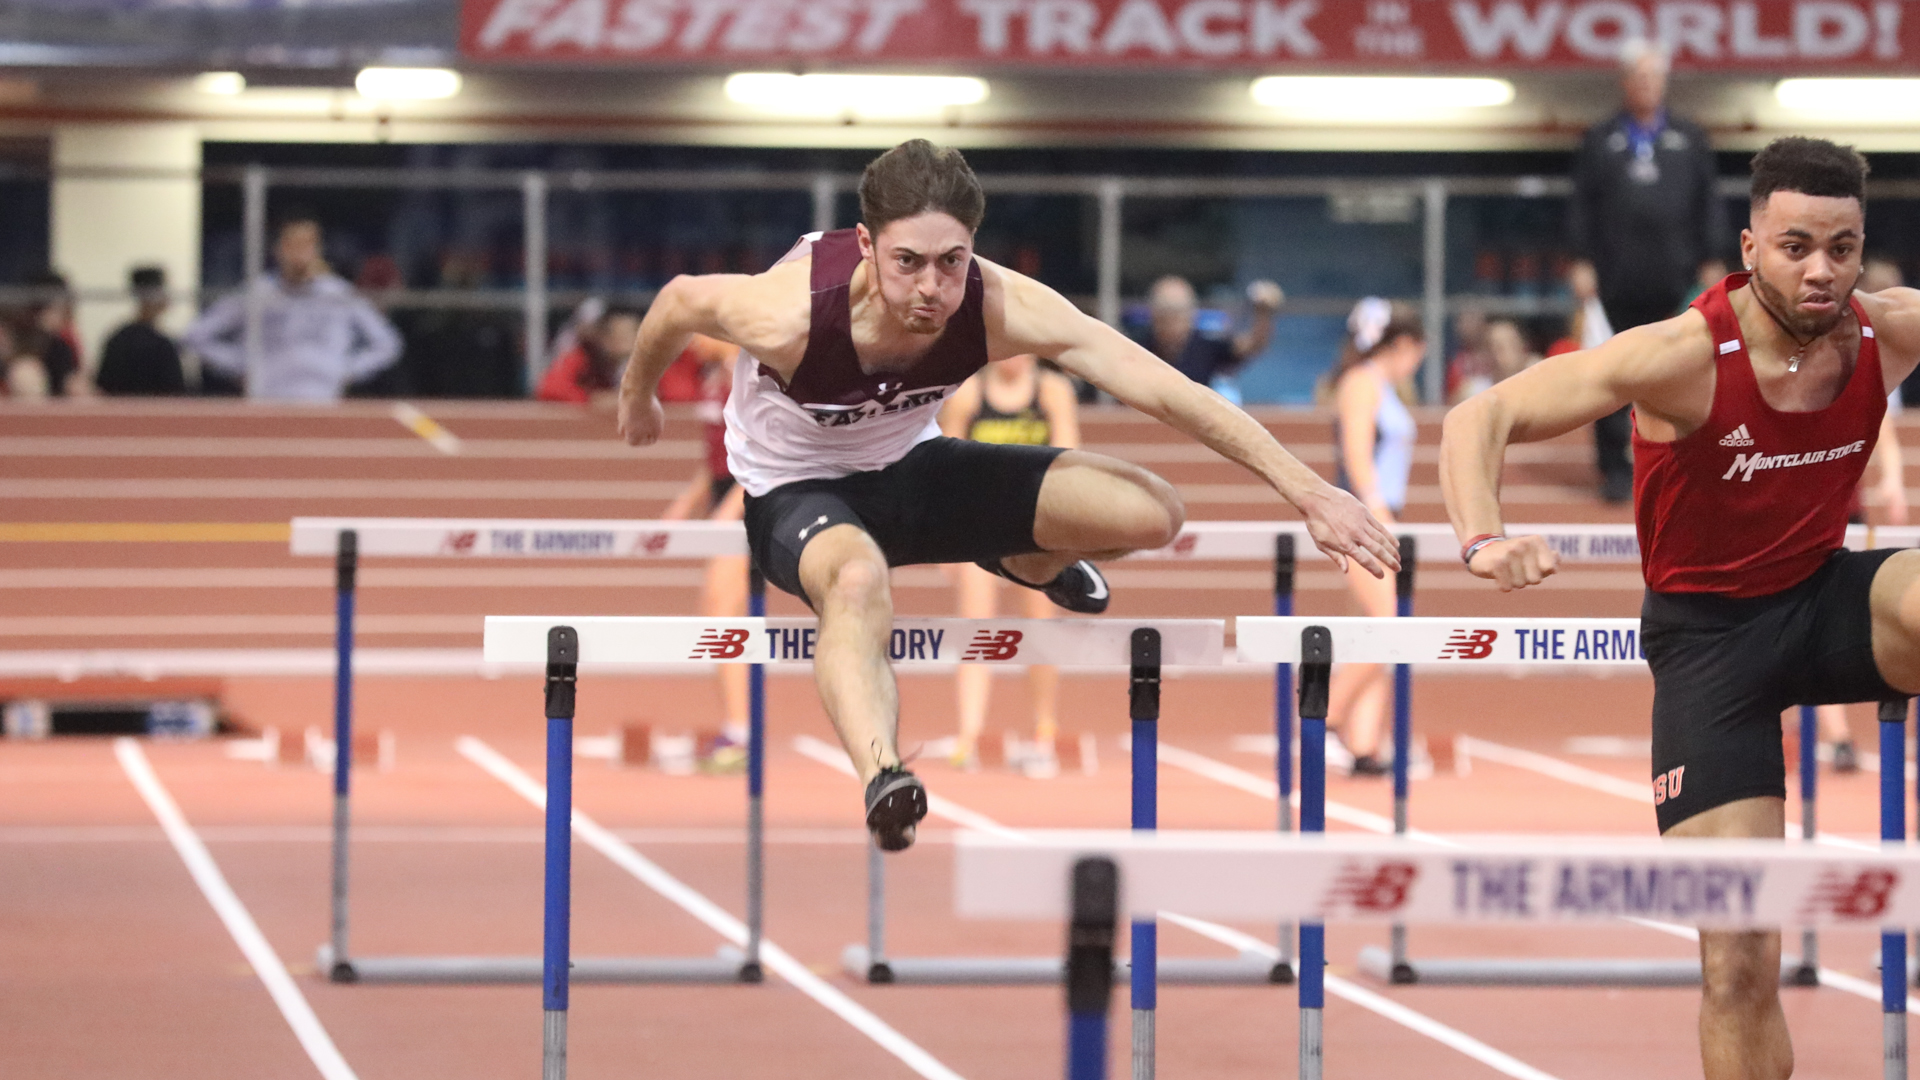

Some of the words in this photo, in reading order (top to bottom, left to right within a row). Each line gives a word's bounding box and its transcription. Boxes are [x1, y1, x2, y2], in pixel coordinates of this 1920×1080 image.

[476, 0, 925, 52] FASTEST
[958, 0, 1322, 55] TRACK
[1448, 0, 1901, 59] WORLD!
[1718, 438, 1755, 447] adidas
[1825, 440, 1866, 461] STATE
[491, 530, 524, 551] THE
[765, 628, 816, 659] THE
[1514, 628, 1566, 660] THE
[1573, 629, 1647, 660] ARM
[1653, 765, 1685, 806] SU
[1450, 860, 1532, 916] THE
[1552, 862, 1764, 917] ARMORY
